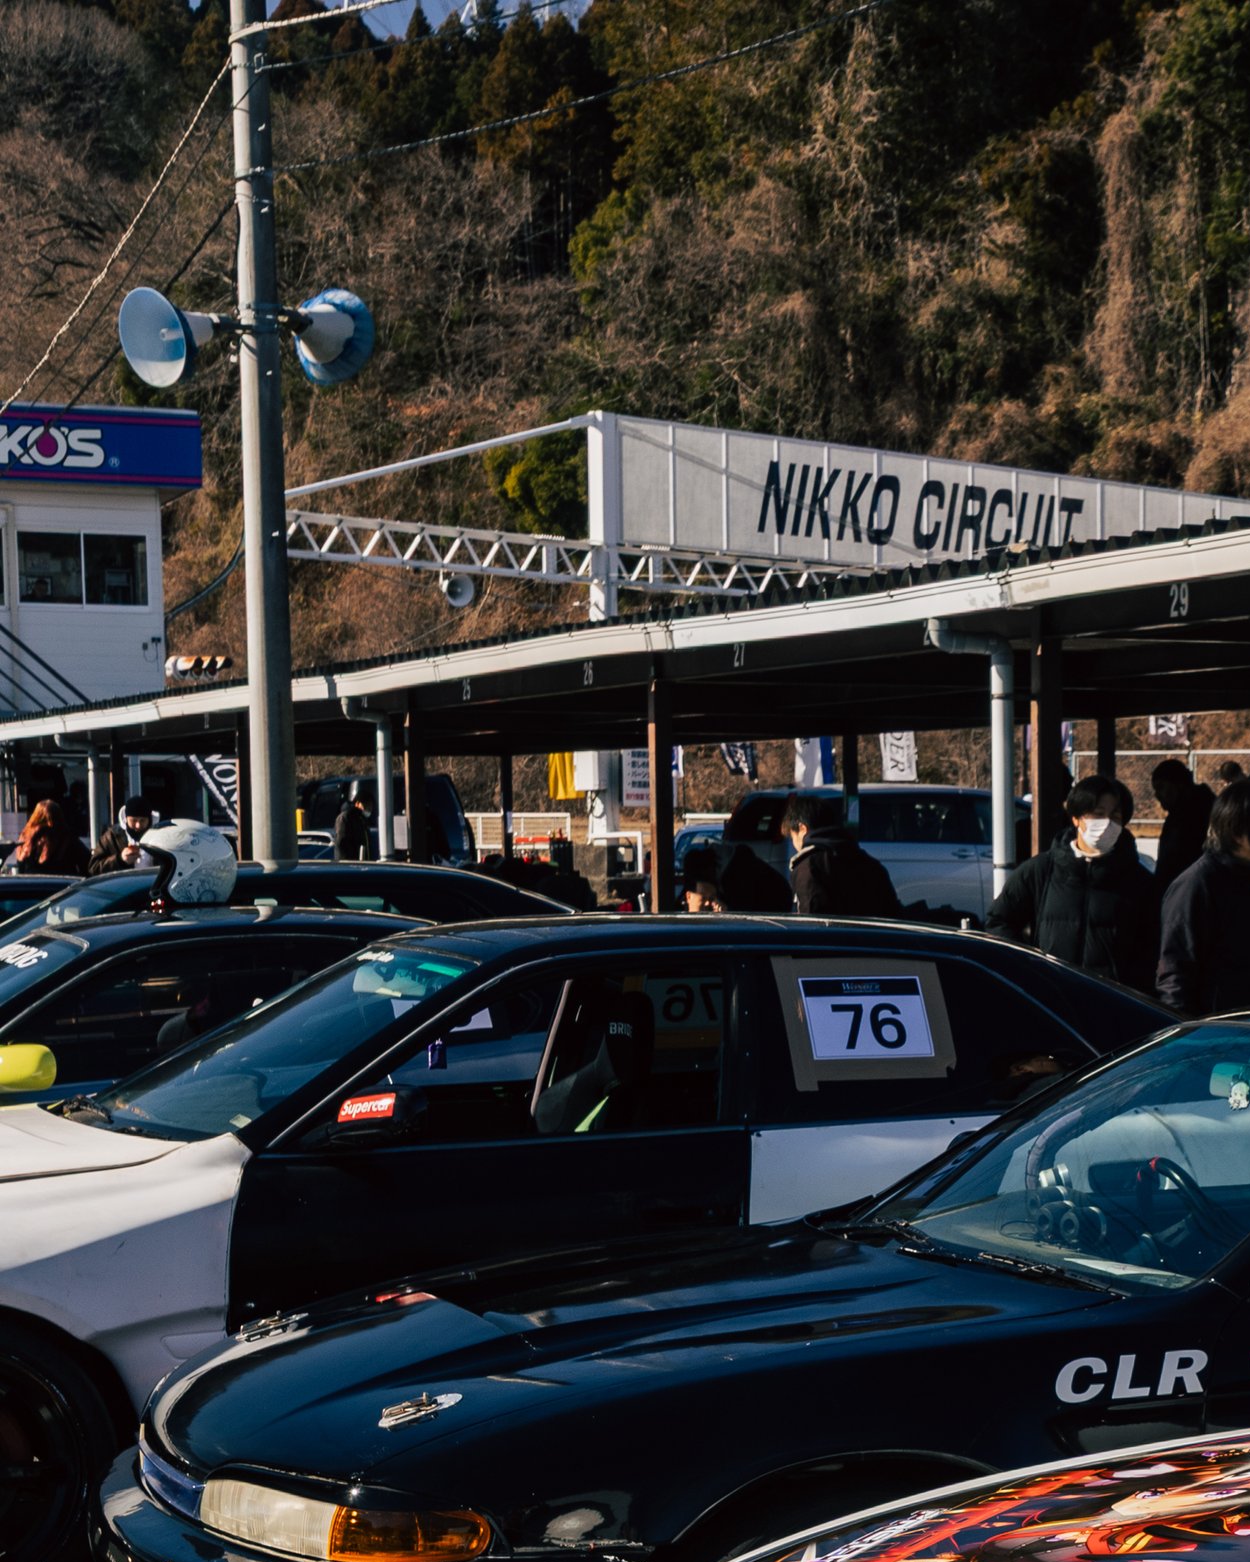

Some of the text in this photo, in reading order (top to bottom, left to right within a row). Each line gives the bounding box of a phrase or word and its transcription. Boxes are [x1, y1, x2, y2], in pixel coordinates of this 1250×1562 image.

[757, 460, 1085, 554] NIKKO CIRCUIT
[1169, 582, 1189, 618] 29
[583, 661, 594, 686] 26
[733, 643, 745, 668] 27
[830, 1003, 907, 1050] 76
[340, 1100, 393, 1119] Supercar
[1055, 1349, 1209, 1404] CLR
